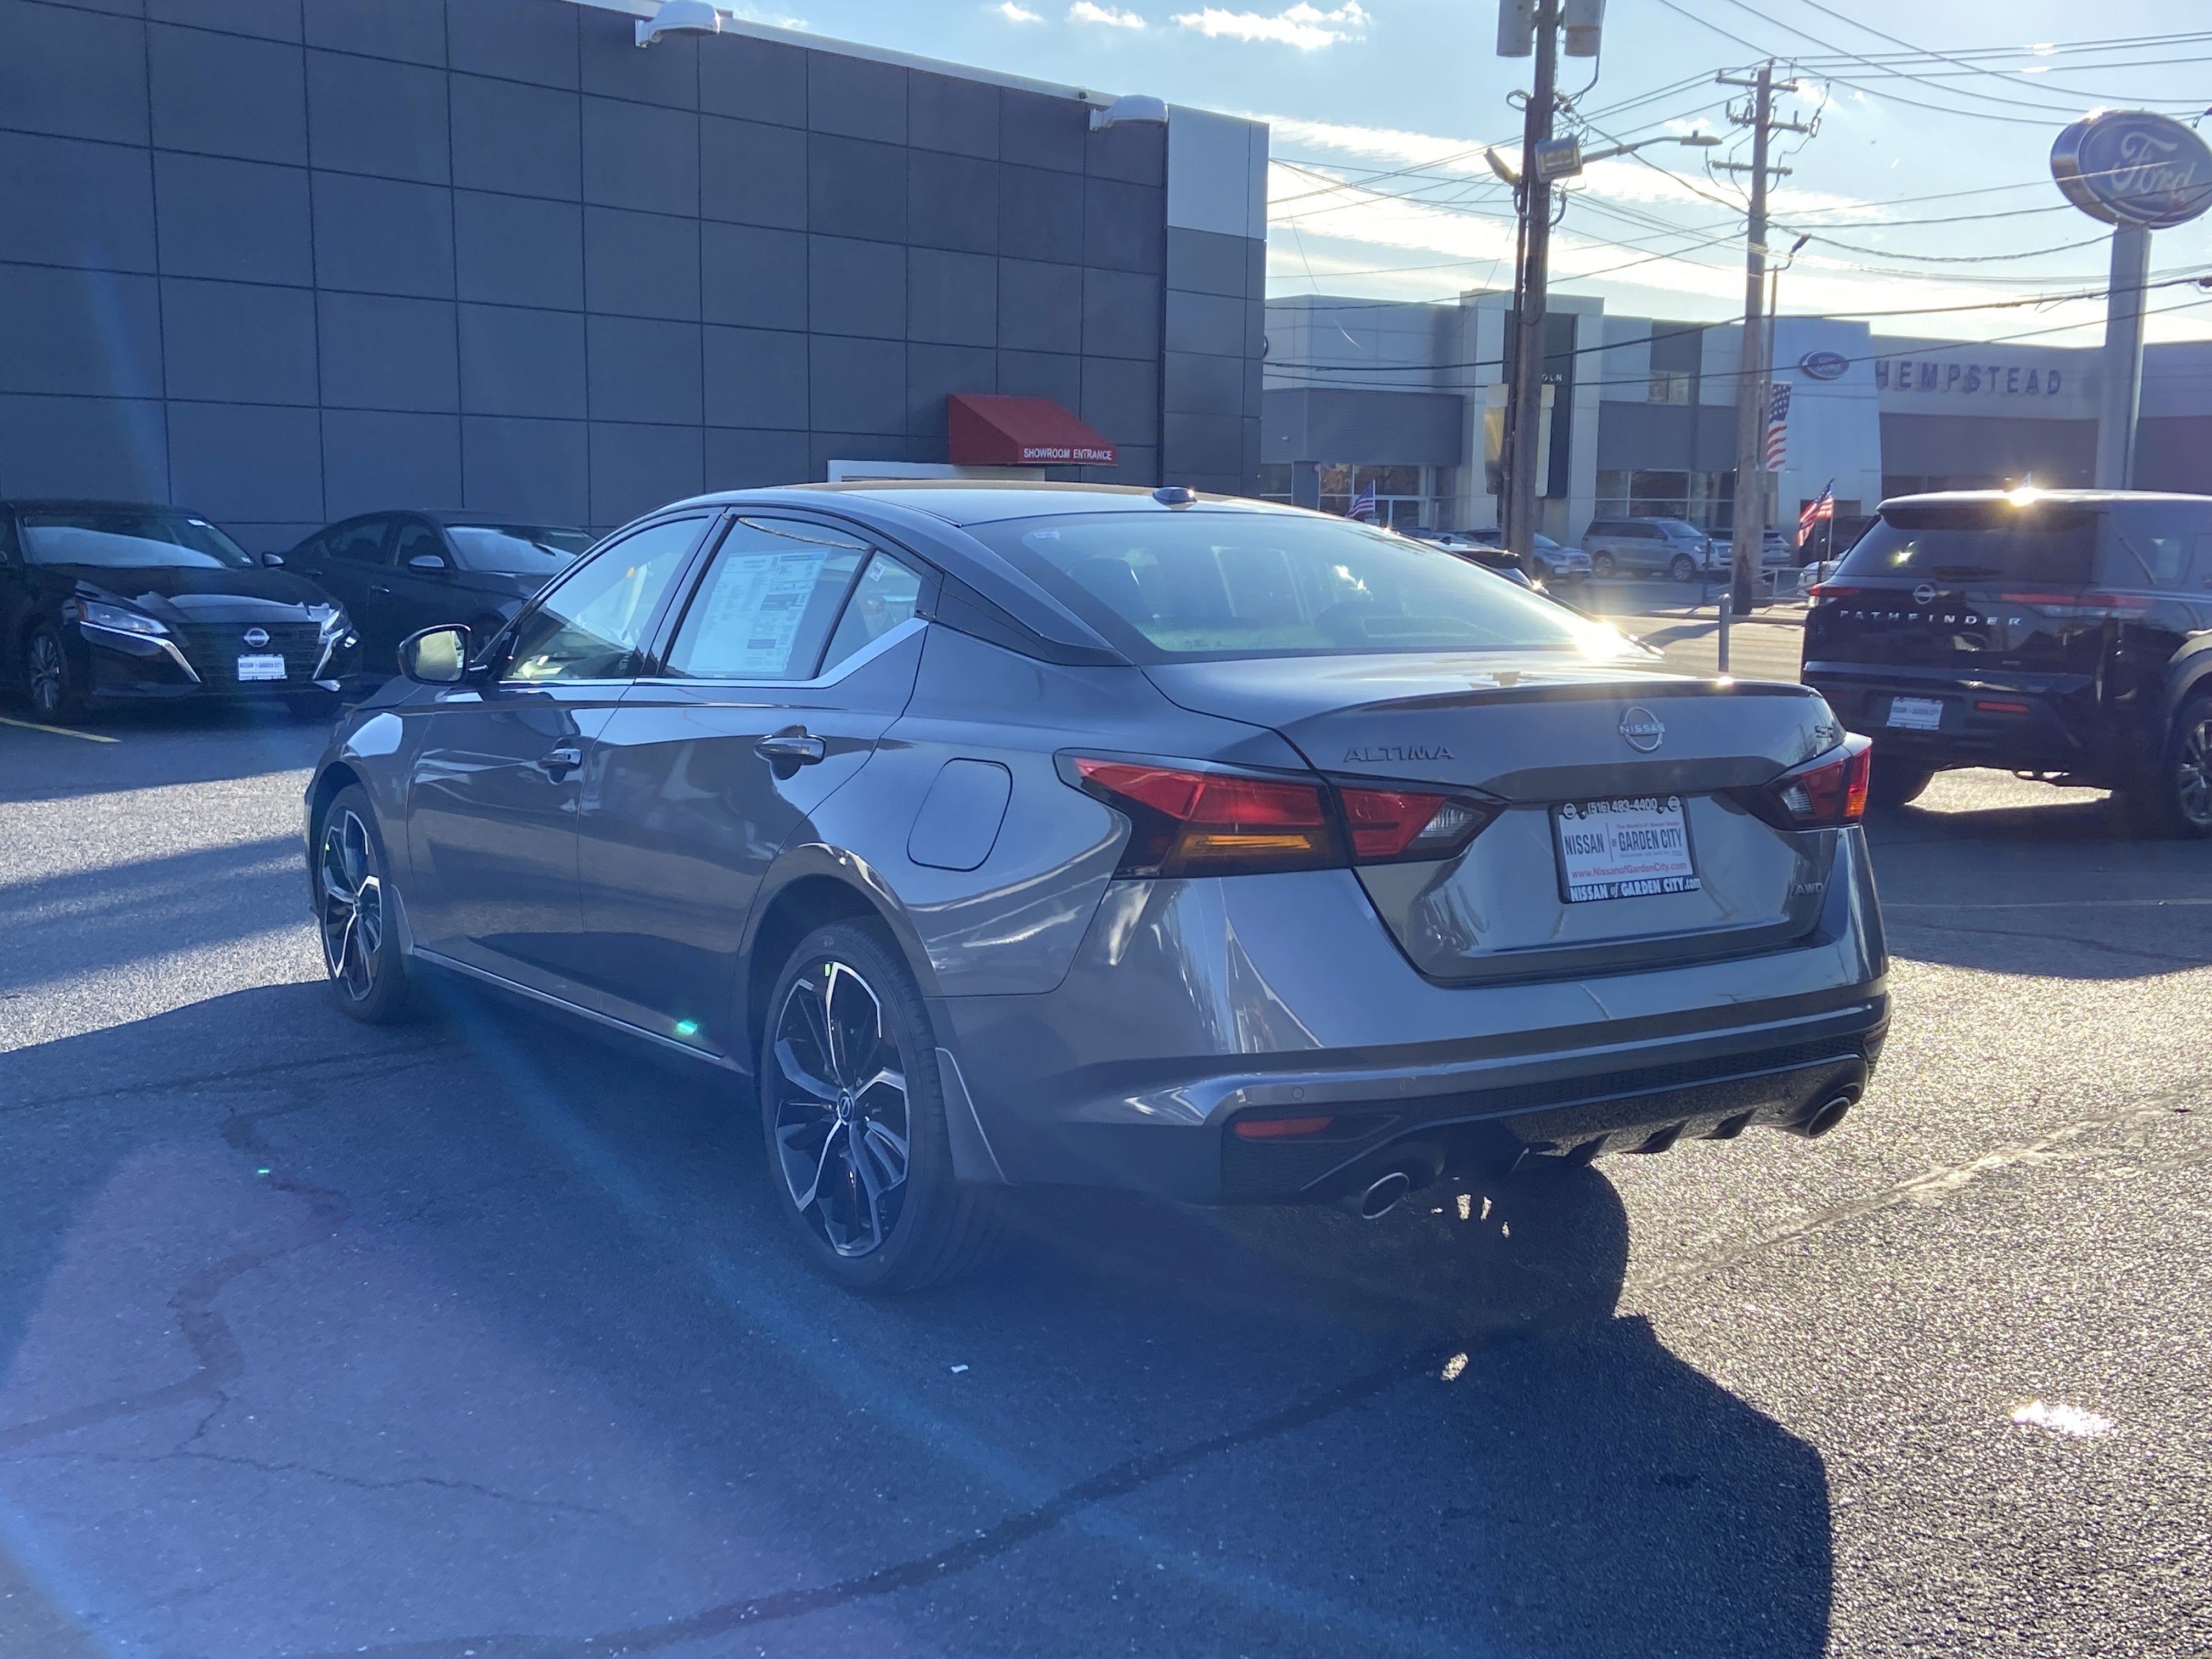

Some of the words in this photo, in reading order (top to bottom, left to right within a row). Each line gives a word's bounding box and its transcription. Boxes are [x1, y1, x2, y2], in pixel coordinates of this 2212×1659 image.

[2111, 131, 2197, 201] Ford
[1875, 360, 2061, 395] HEMPSTEAD
[1024, 448, 1070, 459] SHOWROOM
[1073, 449, 1112, 461] ENTRANCE
[1839, 610, 2022, 626] PATHFINDER
[1619, 723, 1666, 733] NISSAN
[1342, 745, 1455, 763] ALTIMA
[1587, 800, 1610, 814] (516)
[1612, 797, 1658, 813] 483-4400
[1564, 833, 1605, 856] NISSAN
[1618, 830, 1660, 851] GARDEN
[1660, 828, 1682, 849] CITY
[1571, 862, 1688, 878] www.NissanofGardenCity.com
[1570, 884, 1609, 902] NISSAN
[1610, 883, 1619, 899] of
[1620, 879, 1660, 896] GARDEN
[1663, 877, 1701, 892] CITY.com
[1792, 882, 1825, 895] AWD
